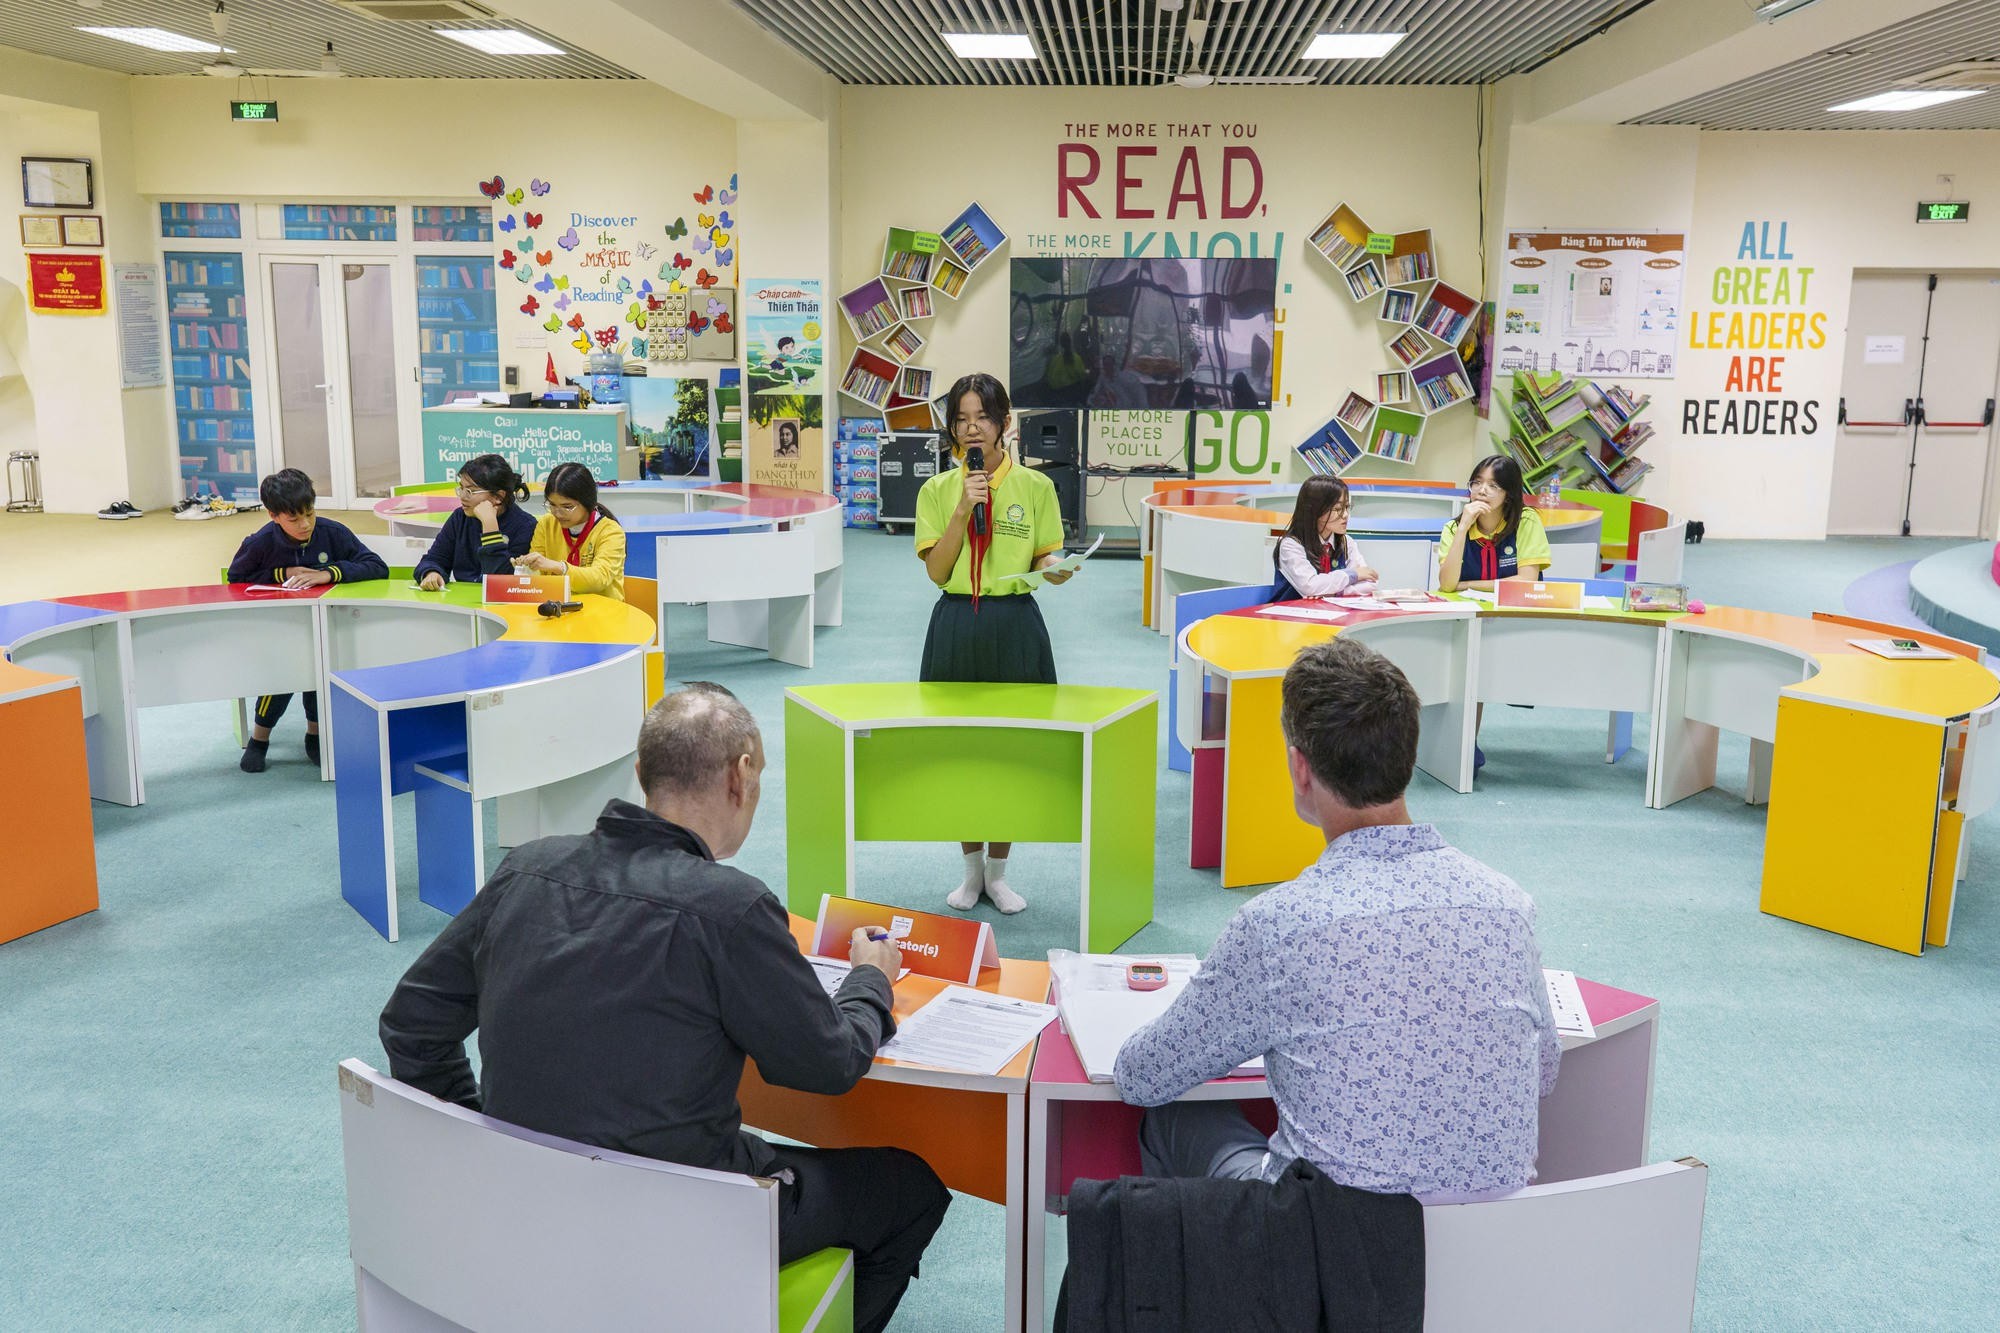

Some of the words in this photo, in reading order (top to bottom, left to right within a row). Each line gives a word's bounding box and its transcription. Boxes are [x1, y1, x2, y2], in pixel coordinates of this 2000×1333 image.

[242, 110, 266, 118] EXIT
[1065, 124, 1099, 137] THE
[1107, 124, 1157, 137] MORE
[1167, 124, 1211, 137] THAT
[1221, 124, 1257, 137] YOU
[1058, 143, 1267, 219] READ,
[571, 213, 638, 228] Discover
[1930, 211, 1956, 219] EXIT
[598, 231, 616, 245] the
[1028, 235, 1057, 248] THE
[1065, 235, 1111, 248] MORE
[1737, 221, 1794, 260] ALL
[580, 248, 631, 269] MAGIC
[600, 270, 611, 284] of
[1711, 267, 1815, 305] GREAT
[572, 287, 624, 304] Reading
[1689, 311, 1828, 349] LEADERS
[1725, 356, 1785, 392] ARE
[1091, 410, 1120, 422] THE
[1128, 410, 1173, 423] MORE
[1682, 399, 1819, 435] READERS
[466, 428, 492, 439] Aloha
[548, 426, 581, 441] Ciao
[1101, 426, 1162, 440] PLACES
[492, 433, 549, 453] Bonjour
[583, 440, 613, 453] Hola
[1184, 410, 1281, 475] GO.
[1106, 443, 1162, 457] YOU'LL
[536, 456, 558, 469] Ola
[1524, 592, 1554, 600] Negative
